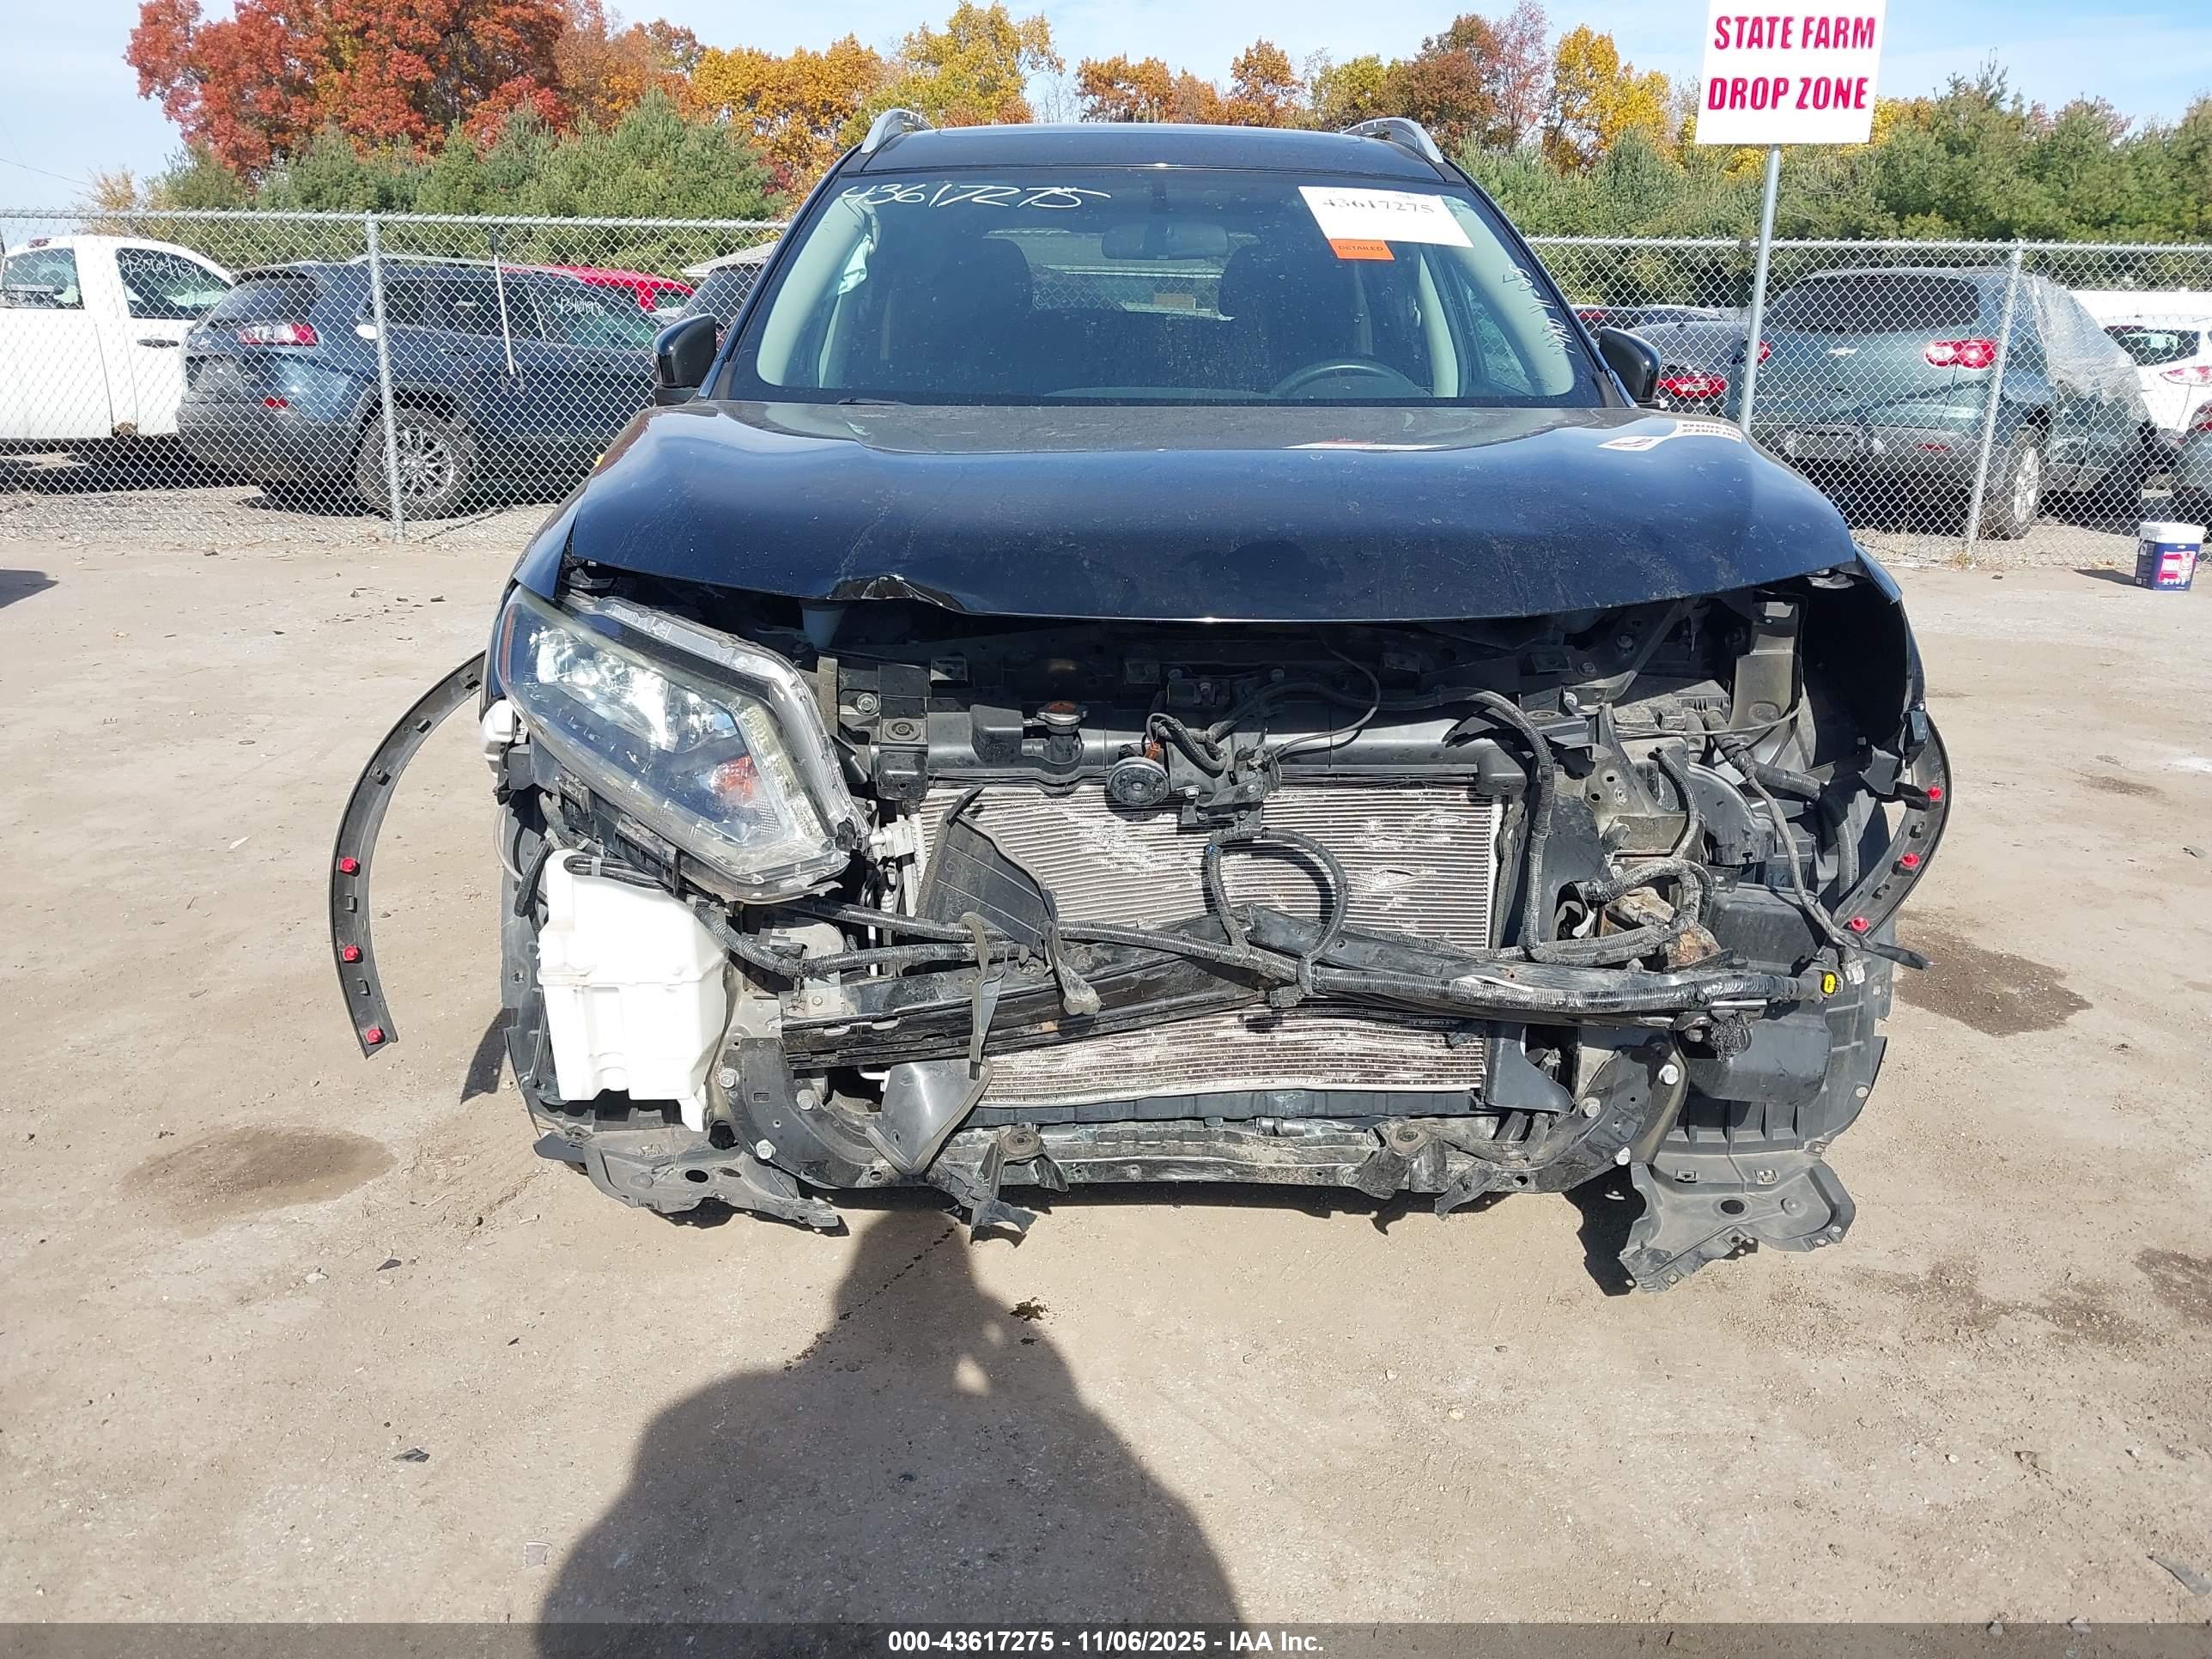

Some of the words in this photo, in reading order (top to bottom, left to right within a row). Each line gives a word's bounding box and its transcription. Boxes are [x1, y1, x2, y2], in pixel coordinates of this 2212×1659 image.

[1714, 16, 1794, 50] STATE
[1801, 16, 1875, 49] FARM
[1707, 77, 1789, 110] DROP
[1795, 76, 1869, 110] ZONE
[841, 183, 1112, 208] 43617275
